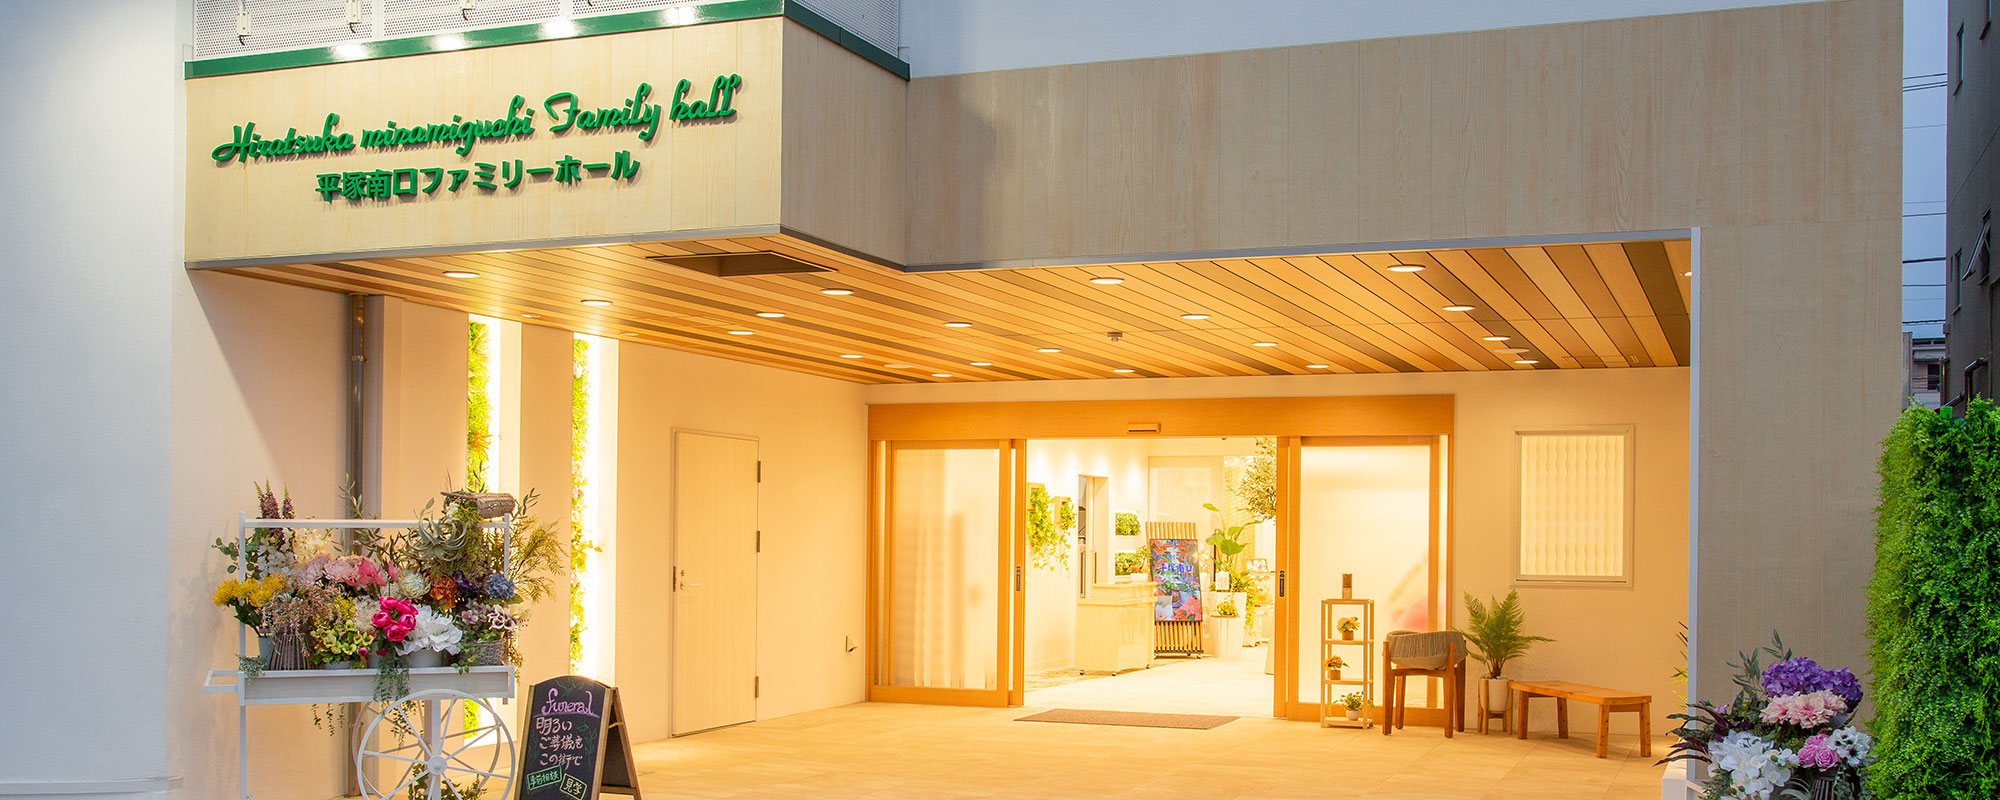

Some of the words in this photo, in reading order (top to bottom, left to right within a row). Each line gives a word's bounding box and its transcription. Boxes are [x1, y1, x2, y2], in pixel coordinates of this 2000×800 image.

[212, 113, 354, 162] Hiratsuka
[360, 95, 533, 156] minamiguchi
[544, 92, 660, 141] Family
[669, 73, 742, 121] hall
[315, 149, 640, 203] 平塚南口ファミリーホール
[541, 687, 593, 716] funeral
[536, 716, 573, 736] 明るい
[539, 733, 583, 751] ご葬儀を
[540, 753, 583, 770] この街で
[530, 770, 559, 788] 事前相談
[563, 777, 583, 795] 見学
